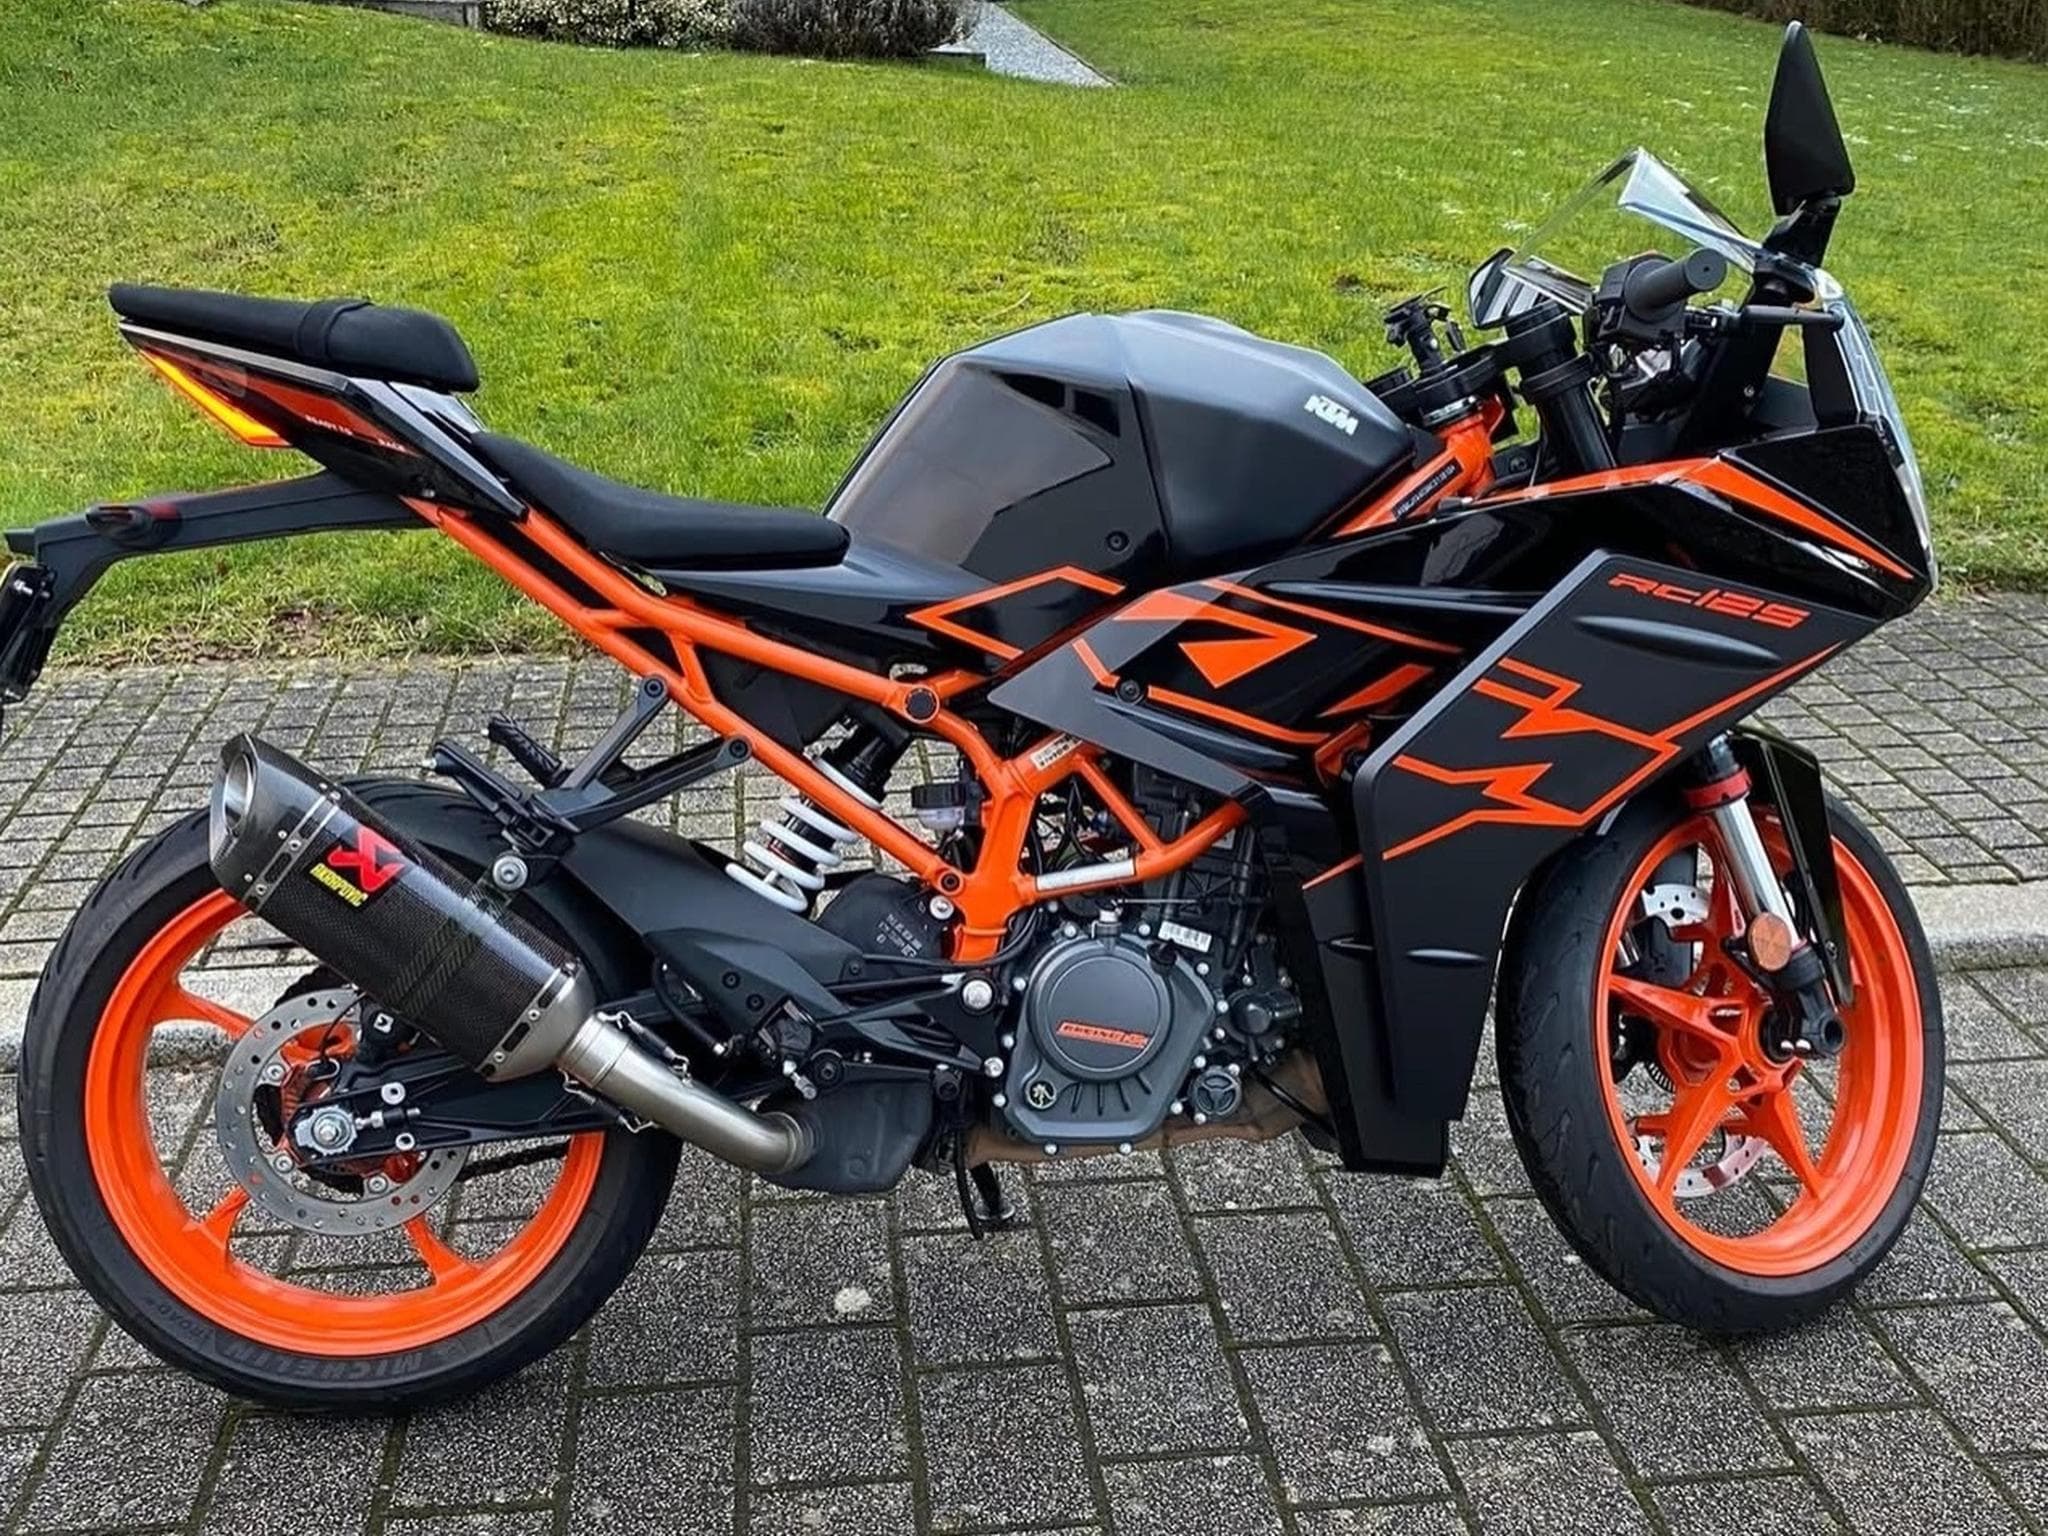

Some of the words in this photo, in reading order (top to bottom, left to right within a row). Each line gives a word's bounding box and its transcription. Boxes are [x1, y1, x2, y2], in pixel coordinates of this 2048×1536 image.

[1304, 395, 1359, 435] KTM
[1608, 573, 1811, 628] RC125
[225, 1341, 423, 1380] MICHELIN
